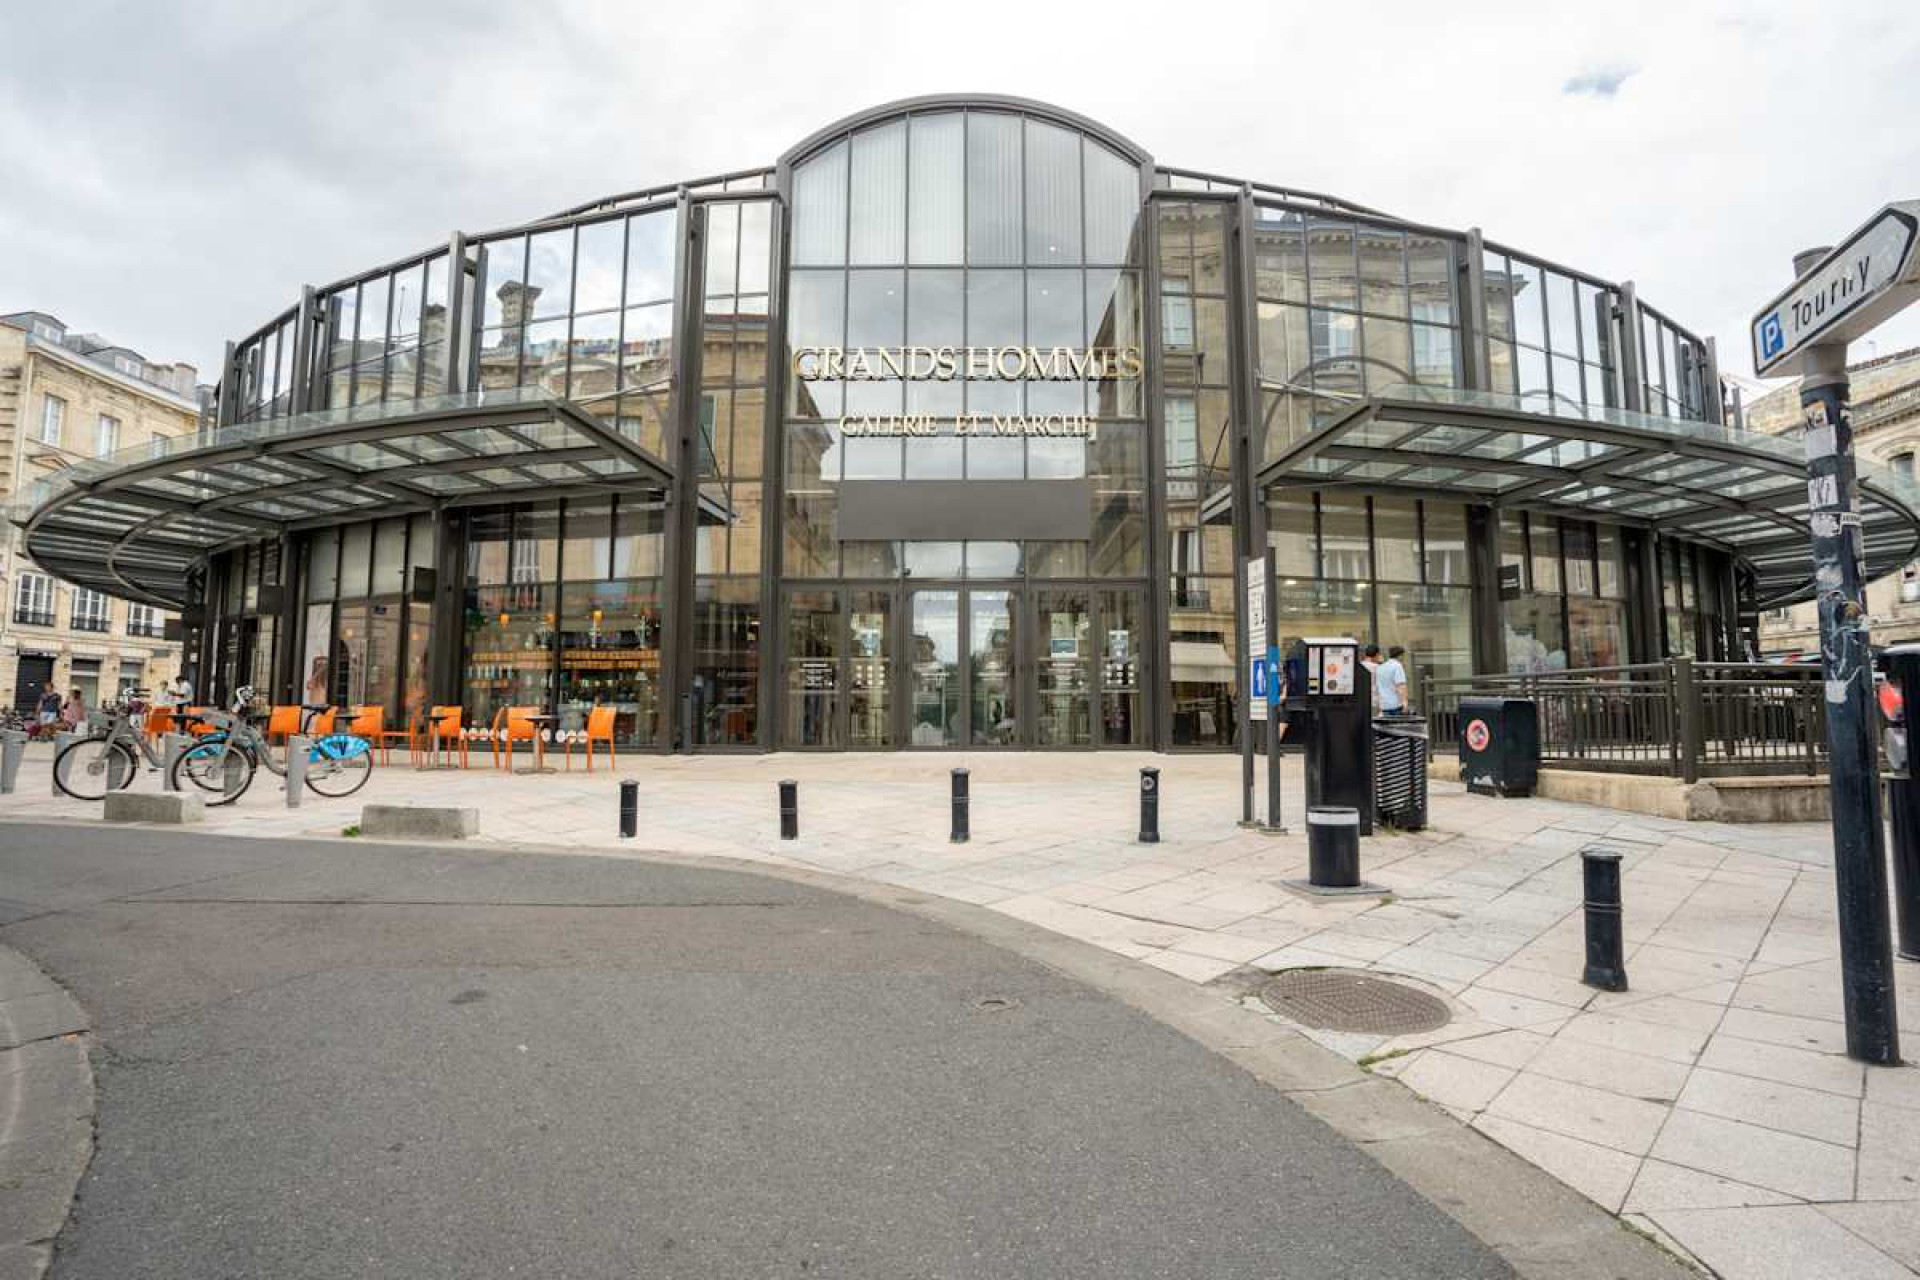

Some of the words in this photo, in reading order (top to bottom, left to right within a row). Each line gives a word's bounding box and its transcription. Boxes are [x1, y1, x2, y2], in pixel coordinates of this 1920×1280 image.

[1765, 321, 1778, 354] P
[1791, 255, 1870, 333] Tourny
[793, 346, 957, 381] GRANDS
[966, 346, 1142, 381] HOMMES
[839, 415, 938, 437] GALERIE
[956, 415, 983, 437] ET
